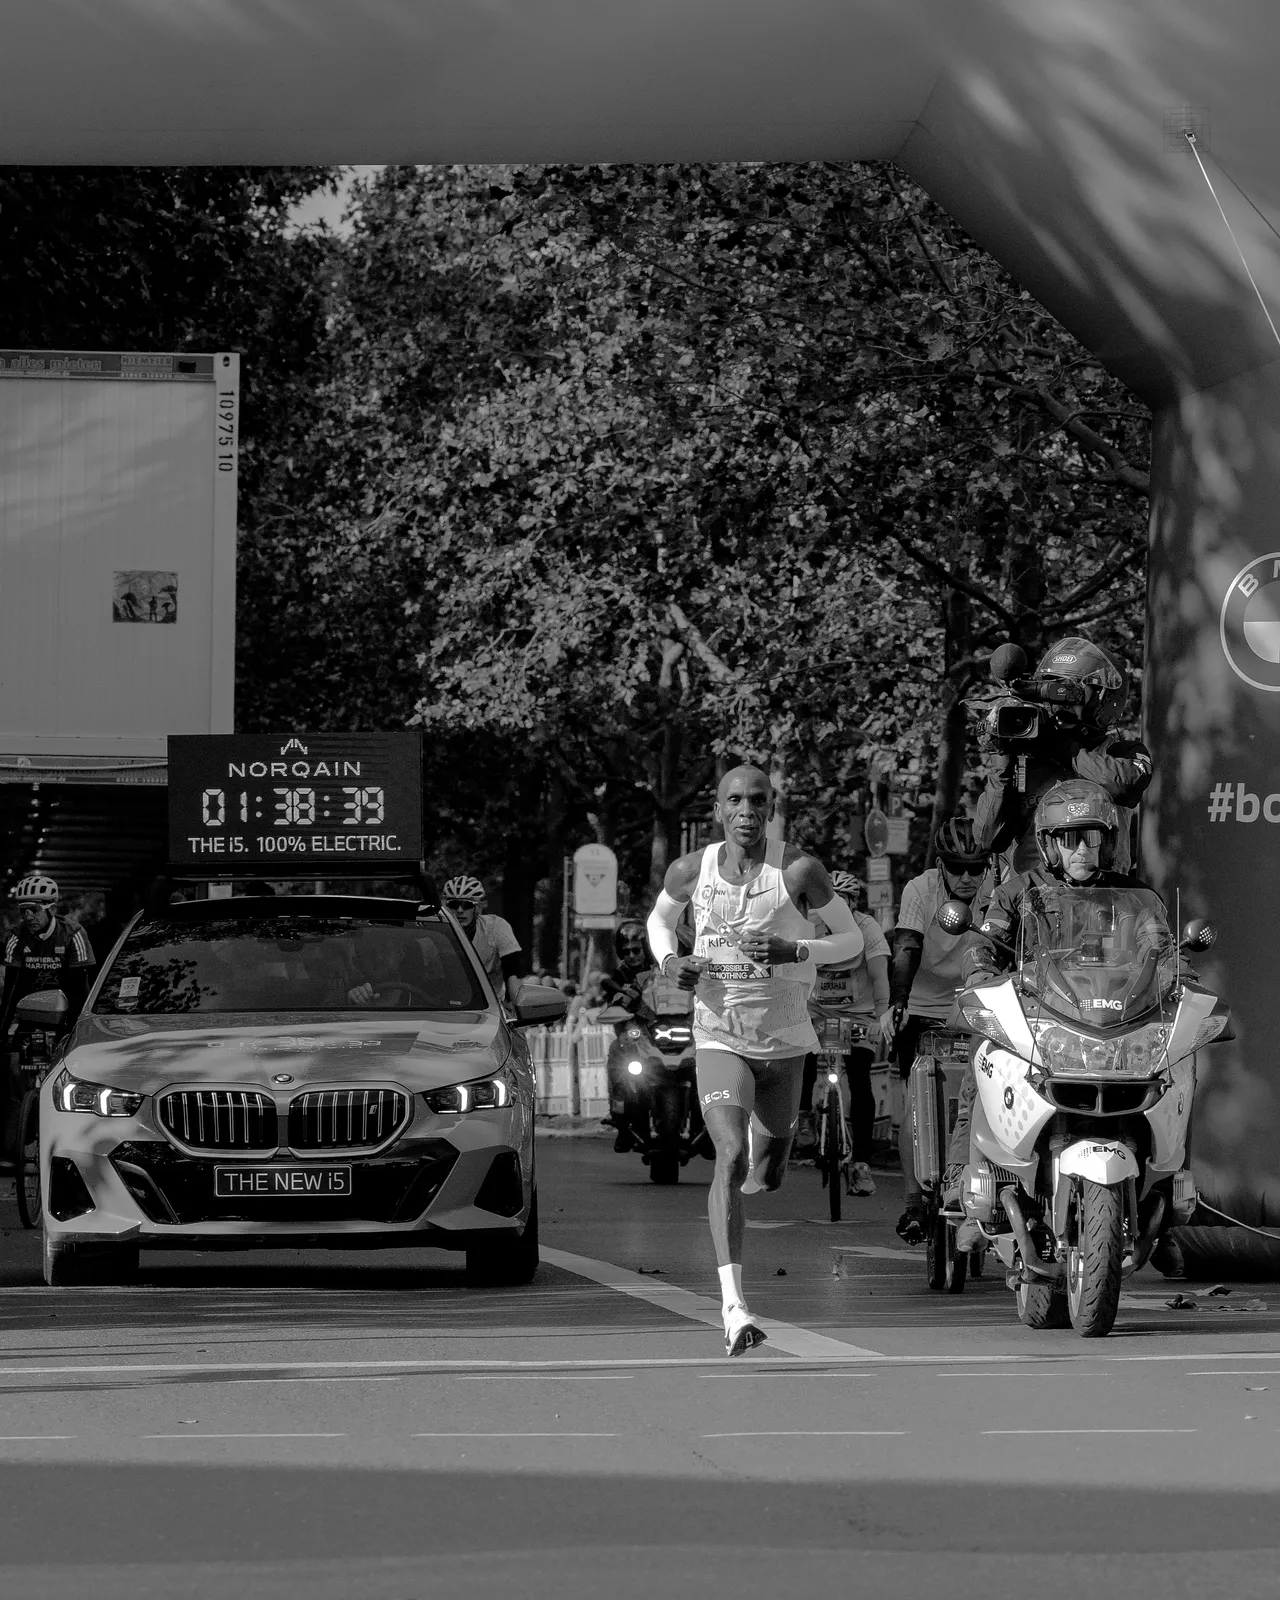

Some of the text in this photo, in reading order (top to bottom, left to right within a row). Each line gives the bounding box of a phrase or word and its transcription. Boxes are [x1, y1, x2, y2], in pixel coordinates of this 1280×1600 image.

[10, 355, 45, 369] alles
[49, 356, 102, 371] mieten
[218, 390, 235, 472] 10975 10
[228, 761, 361, 778] NORQAIN
[187, 835, 402, 853] THE i5. 100% ELECTRIC.
[709, 964, 749, 972] IMPOSSIBLE
[1092, 998, 1123, 1011] EMG
[981, 1056, 994, 1079] EMG
[1092, 1146, 1126, 1160] EMG
[223, 1172, 345, 1191] THE NEW i5
